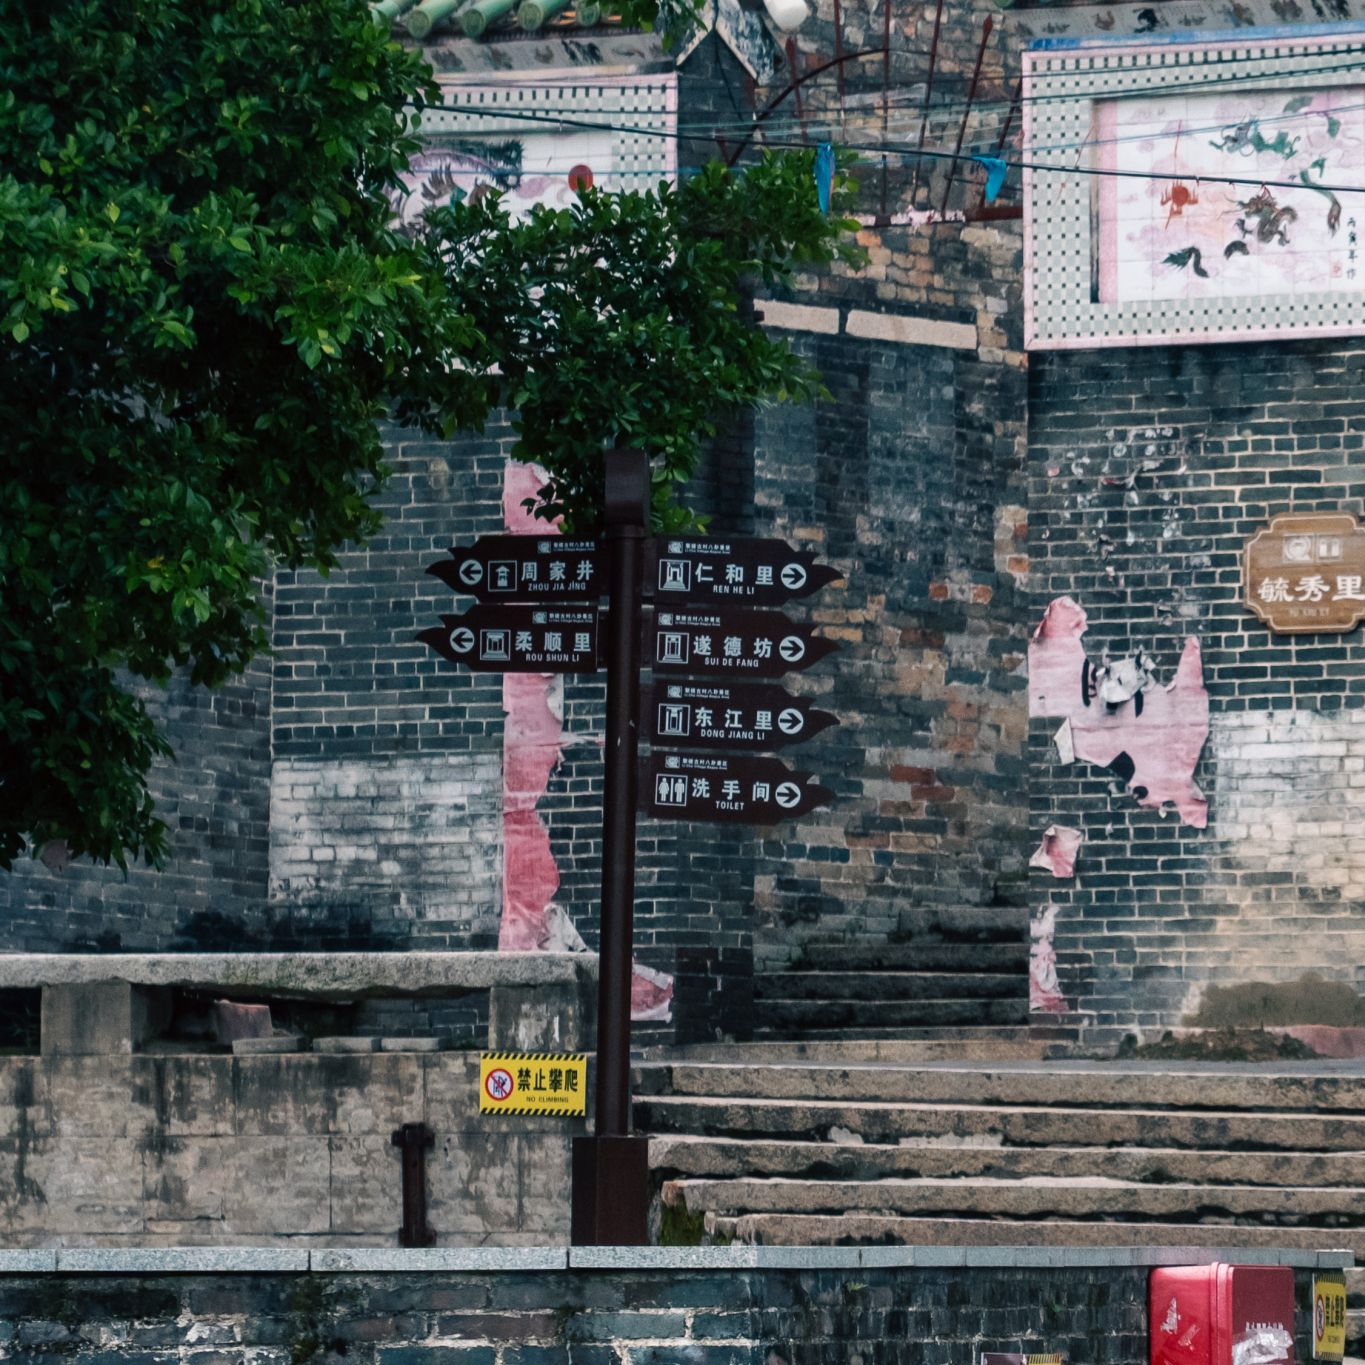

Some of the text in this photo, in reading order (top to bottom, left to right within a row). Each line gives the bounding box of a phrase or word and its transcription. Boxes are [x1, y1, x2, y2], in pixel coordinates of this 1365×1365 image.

[521, 560, 594, 582] 周家井
[695, 562, 774, 585] 仁和里
[528, 583, 549, 592] ZHOU
[552, 582, 565, 591] JIA
[713, 585, 755, 595] REN HE LI
[515, 631, 591, 652] 柔顺里
[693, 635, 773, 658] 遂德坊
[526, 653, 580, 662] ROU SHUN LI
[704, 657, 759, 667] SUI DE FANG
[695, 707, 773, 730] 东江里
[701, 729, 765, 740] DONG JIANG LI
[692, 777, 770, 802] 洗手间
[715, 800, 744, 811] TOILET
[517, 1067, 578, 1092] 禁止攀爬
